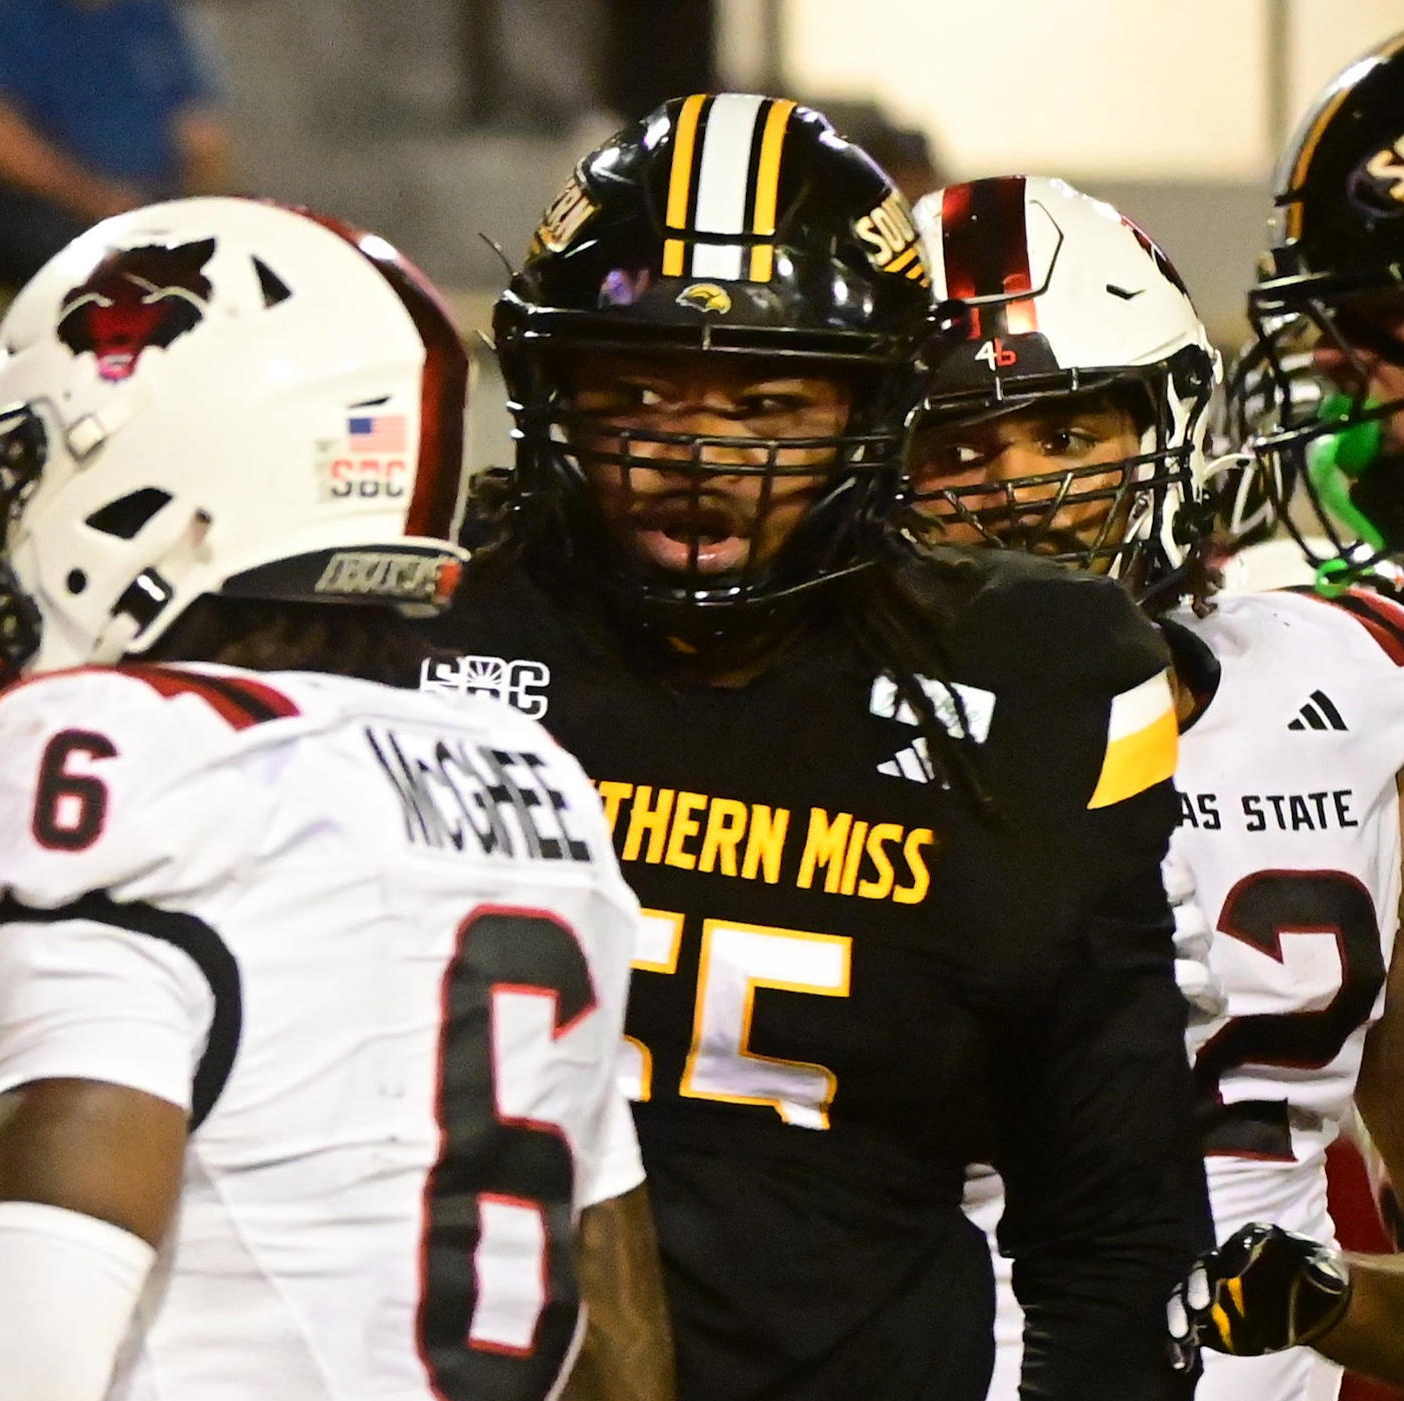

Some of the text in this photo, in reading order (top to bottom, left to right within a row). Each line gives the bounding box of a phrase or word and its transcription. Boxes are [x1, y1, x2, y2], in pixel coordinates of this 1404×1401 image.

[32, 727, 121, 853] 6
[1242, 789, 1358, 832] STATE
[795, 806, 935, 905] MISS
